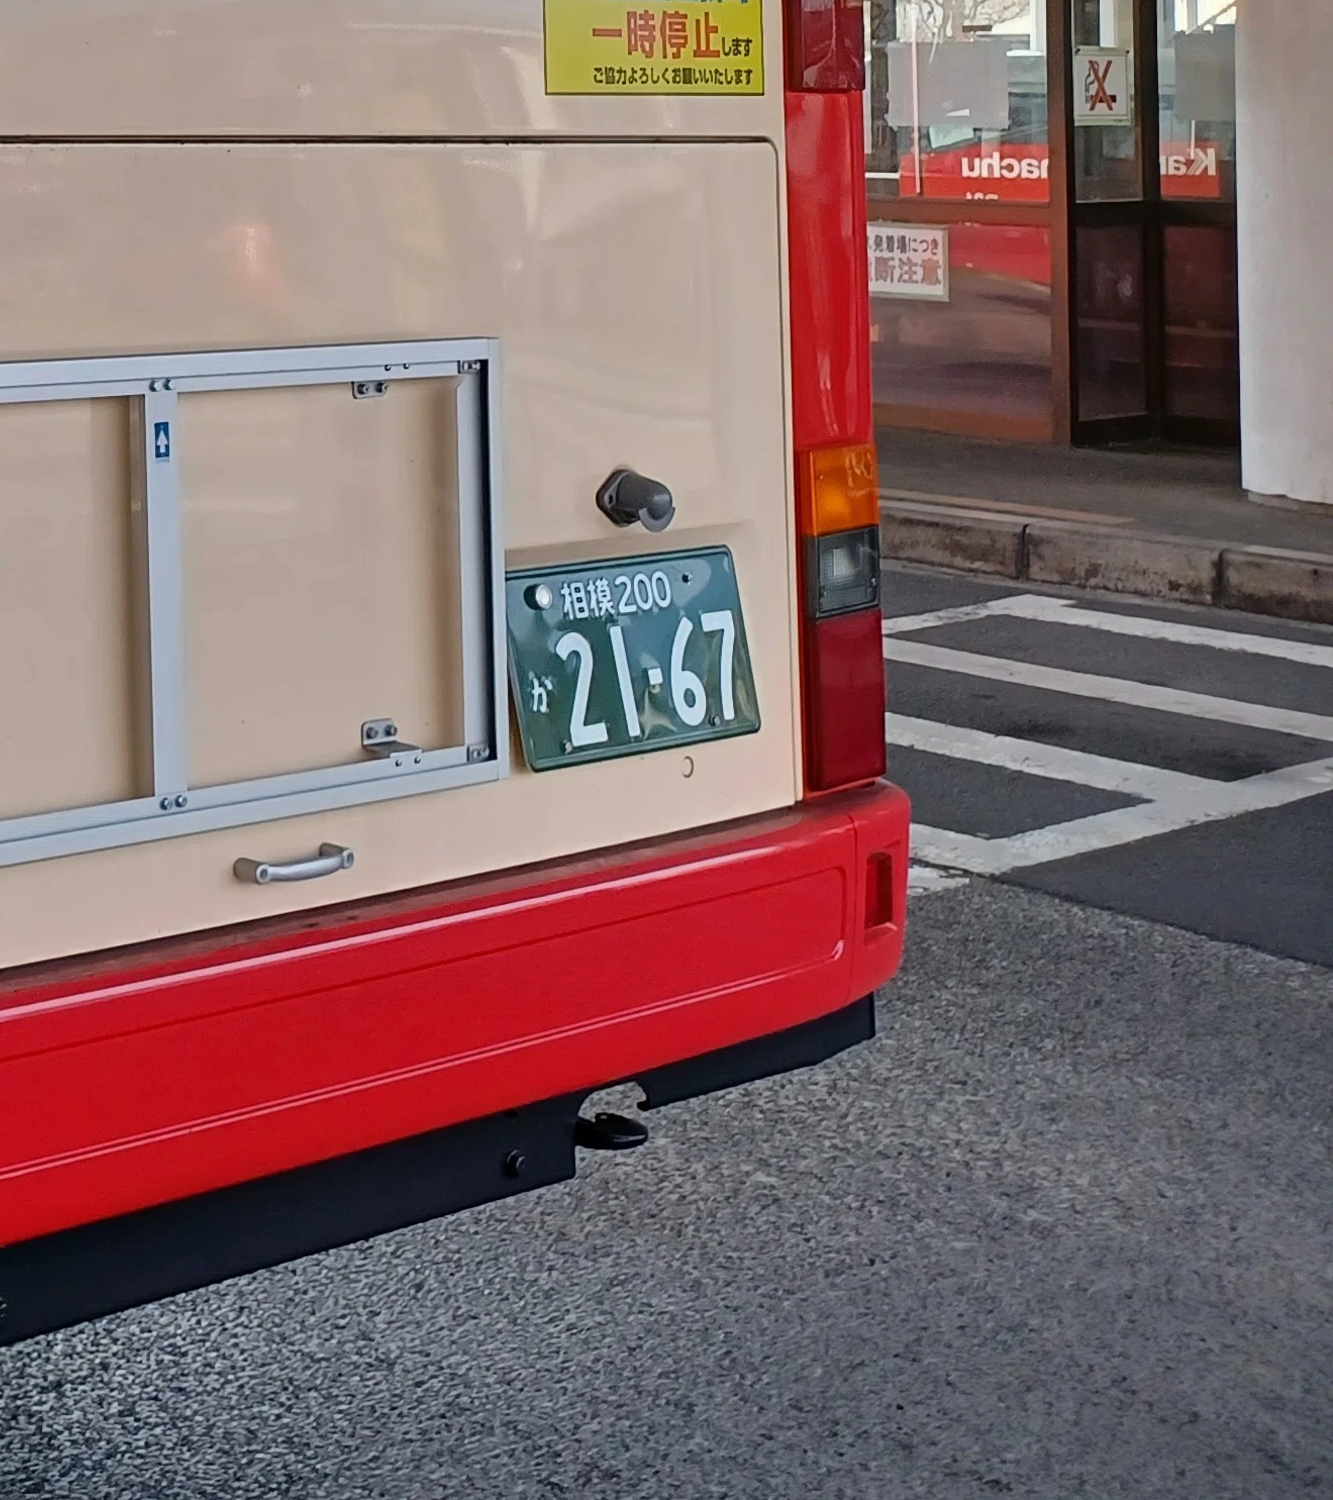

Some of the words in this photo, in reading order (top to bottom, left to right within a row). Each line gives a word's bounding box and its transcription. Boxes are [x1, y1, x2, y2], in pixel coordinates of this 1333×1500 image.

[867, 234, 939, 255] 発着場につき
[868, 257, 941, 286] 断注意
[528, 671, 554, 714] か
